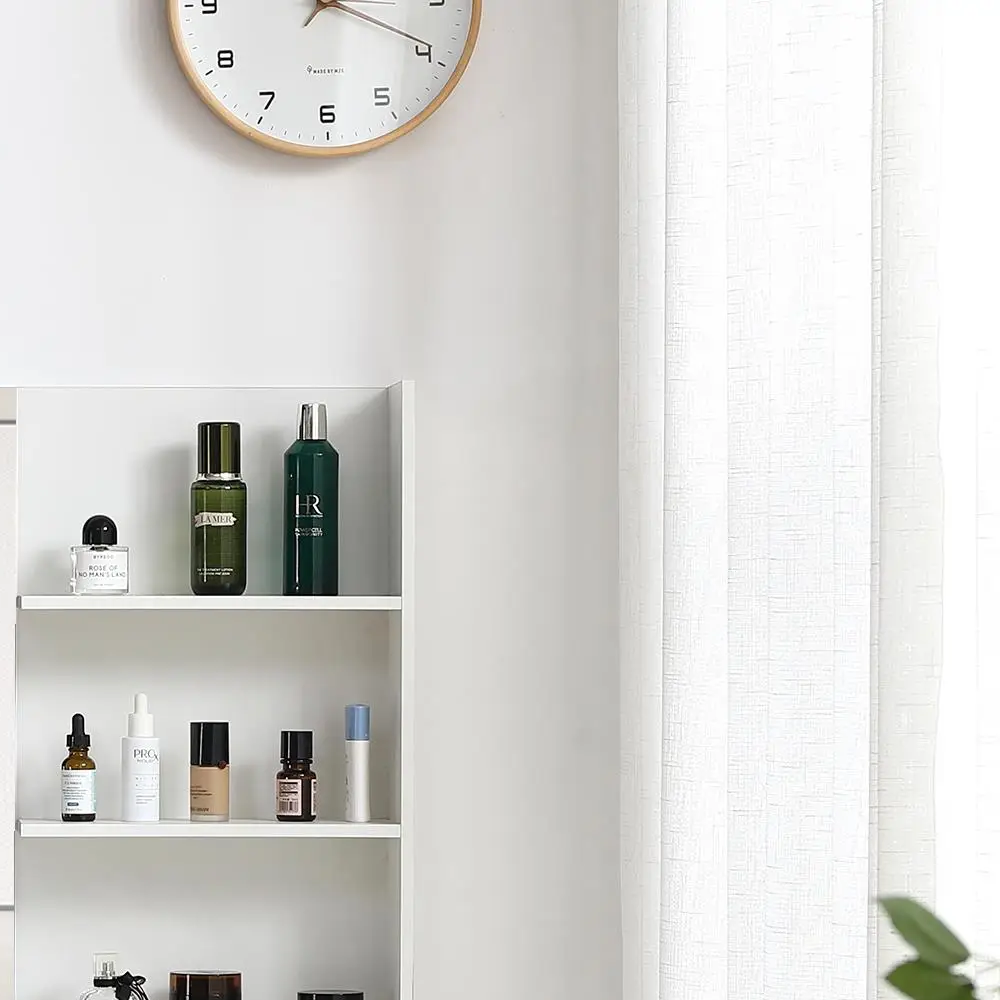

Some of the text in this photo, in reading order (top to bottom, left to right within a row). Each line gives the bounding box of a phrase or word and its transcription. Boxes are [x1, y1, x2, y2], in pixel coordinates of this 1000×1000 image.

[201, 0, 217, 14] 9
[217, 49, 234, 68] 8
[415, 45, 432, 63] 4
[259, 91, 275, 110] 7
[374, 87, 390, 106] 5
[319, 104, 336, 124] 6
[295, 494, 323, 515] HR
[212, 515, 232, 523] MER
